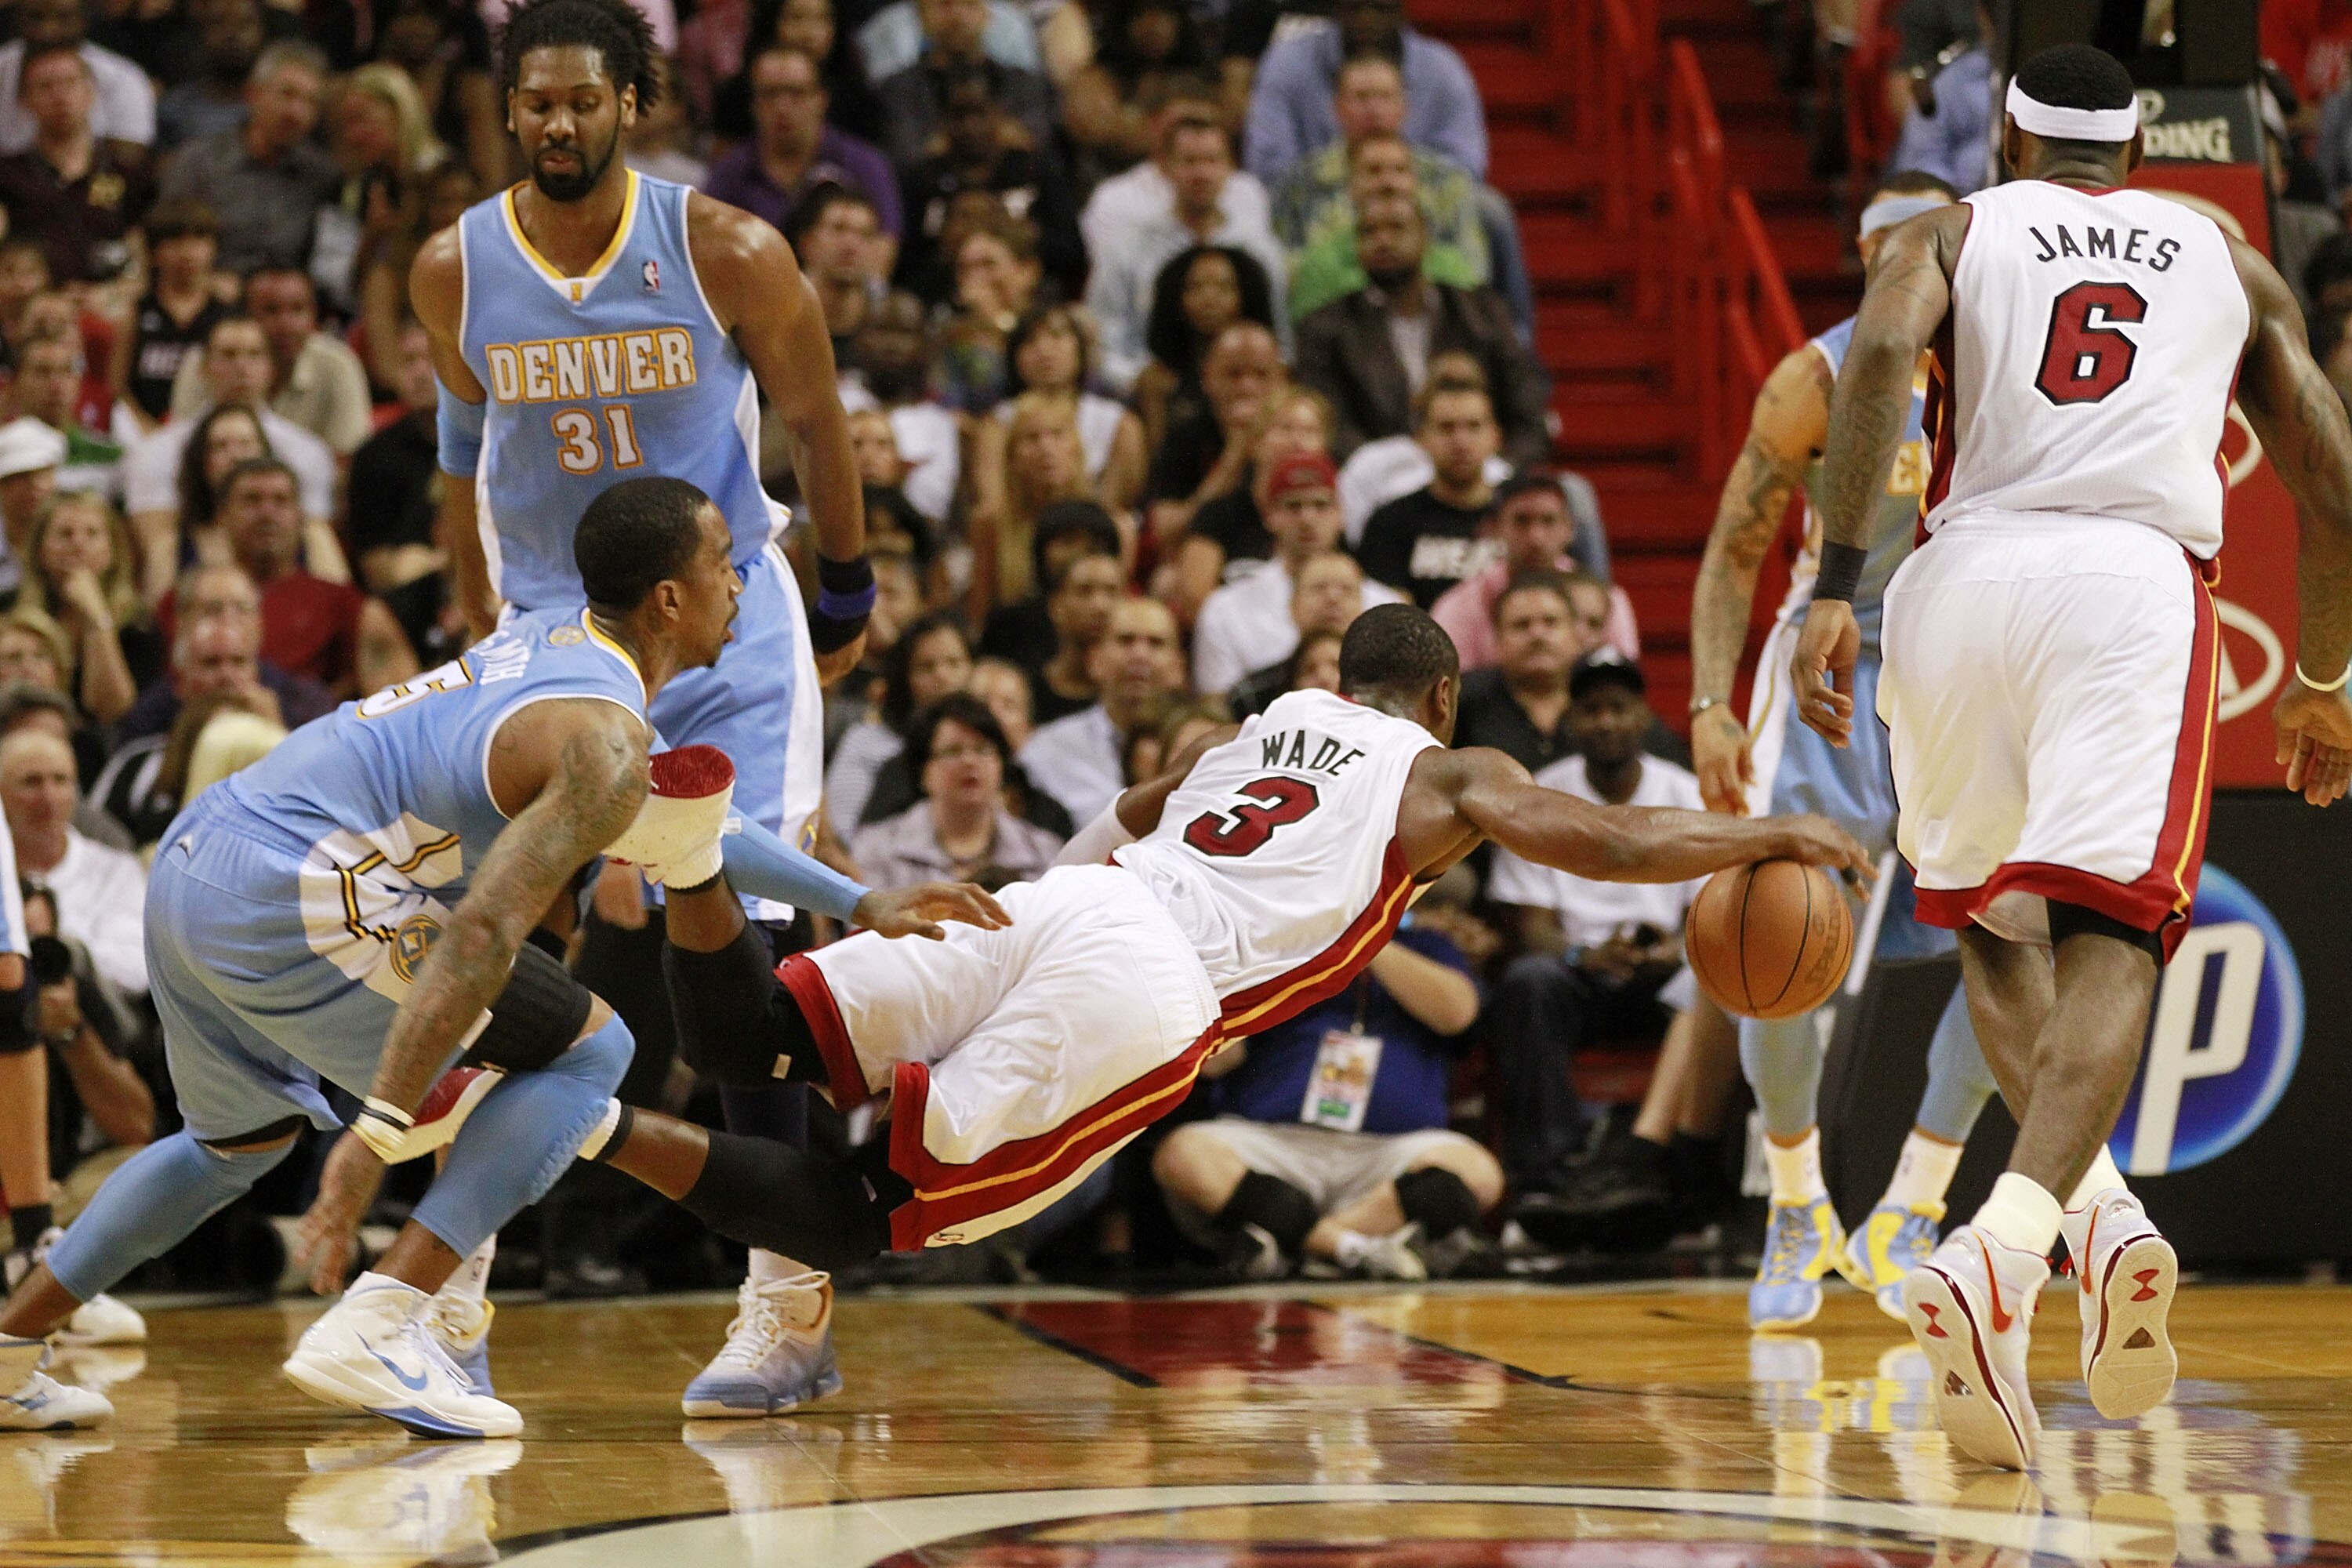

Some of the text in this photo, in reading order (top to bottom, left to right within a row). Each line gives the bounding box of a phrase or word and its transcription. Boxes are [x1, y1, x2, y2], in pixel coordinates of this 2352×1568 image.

[2029, 224, 2182, 272] JAMES
[485, 327, 697, 404] DENVER
[2033, 279, 2149, 407] 6
[552, 404, 644, 475] 31
[1261, 730, 1366, 776] WADE
[1182, 775, 1320, 857] 3
